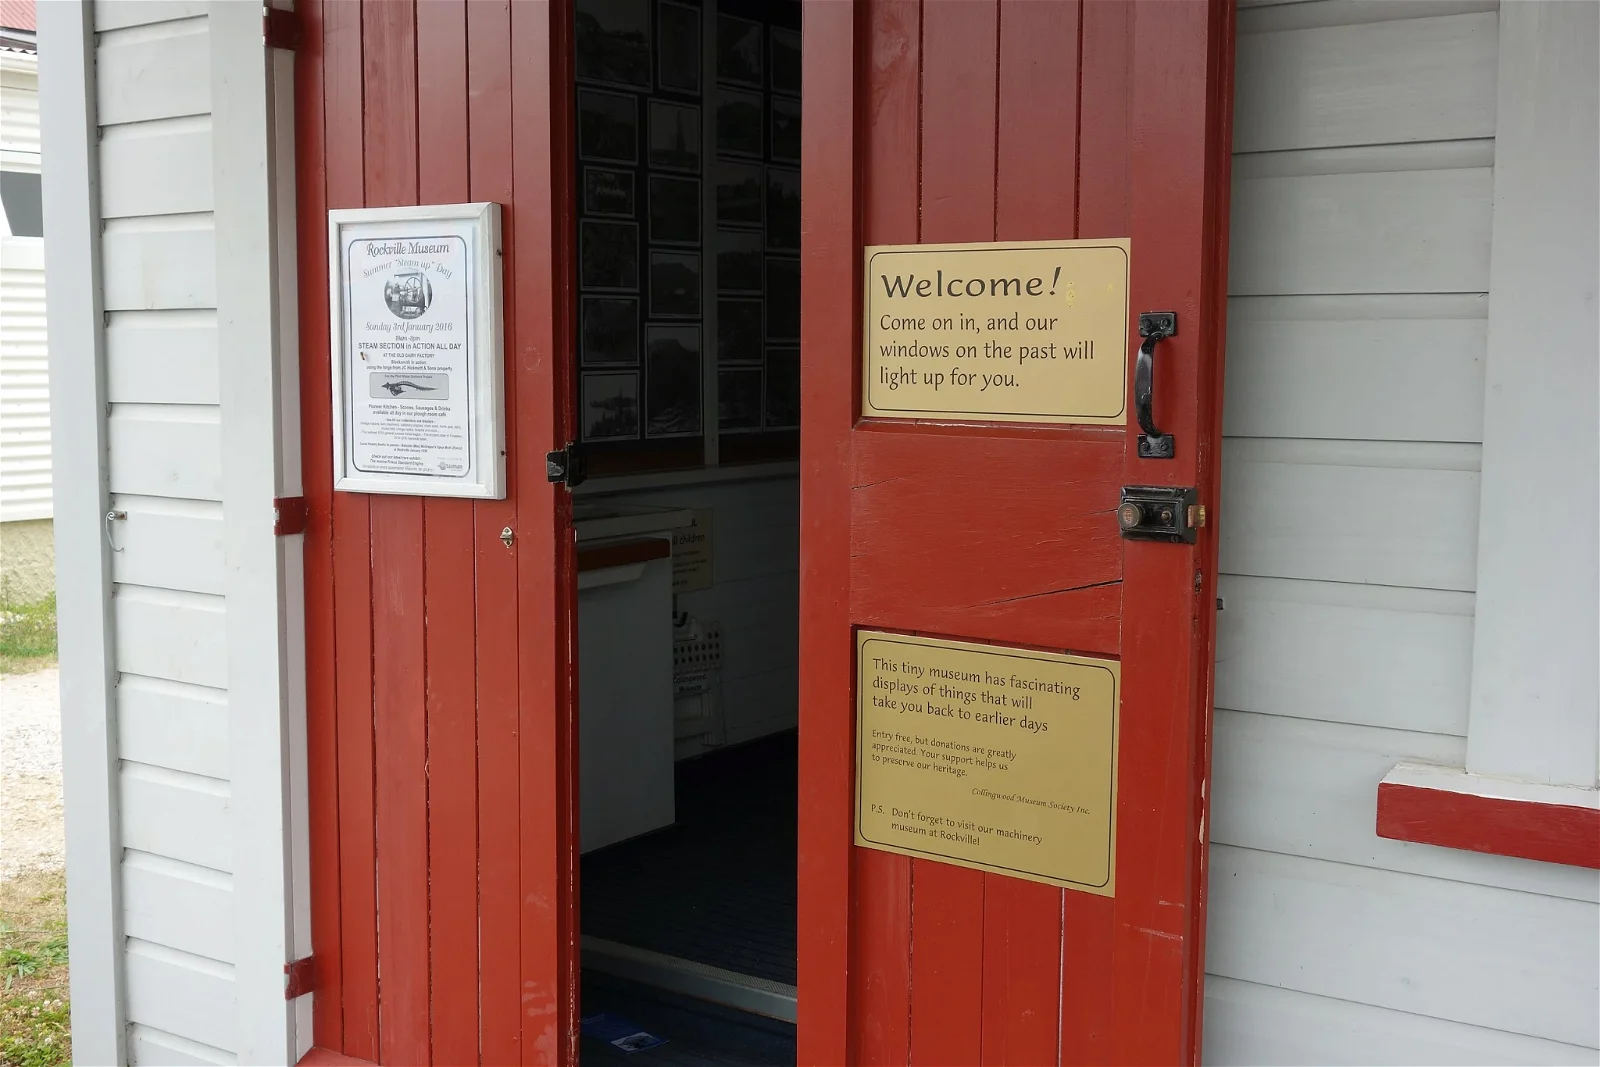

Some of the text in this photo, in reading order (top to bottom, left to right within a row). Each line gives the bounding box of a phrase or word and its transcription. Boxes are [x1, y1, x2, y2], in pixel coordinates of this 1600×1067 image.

[366, 241, 450, 257] Rockville Museum
[363, 261, 392, 278] Summer
[436, 262, 453, 280] Day
[881, 266, 1061, 298] Welcome!
[365, 321, 453, 333] Sunday 3rd January 2016
[880, 312, 1058, 334] Come on in, and our
[880, 340, 1094, 365] windows on the past will
[880, 366, 1020, 391] light up for you.
[679, 531, 705, 545] children
[872, 658, 1081, 700] This tiny museum has fascinating
[872, 676, 1033, 709] displays of things that will
[872, 695, 1048, 734] take you back to earlier days
[871, 741, 1008, 771] appreciated. Your support helps us
[872, 729, 1017, 761] Entry free, but donations are greatly
[871, 753, 968, 777] to preserve our heritage.
[871, 804, 885, 815] P.S.
[971, 787, 1091, 815] Collingwood Museum Society Inc.
[891, 807, 1043, 845] Don't forget to visit our machinery
[891, 822, 981, 846] museum at Rockville!
